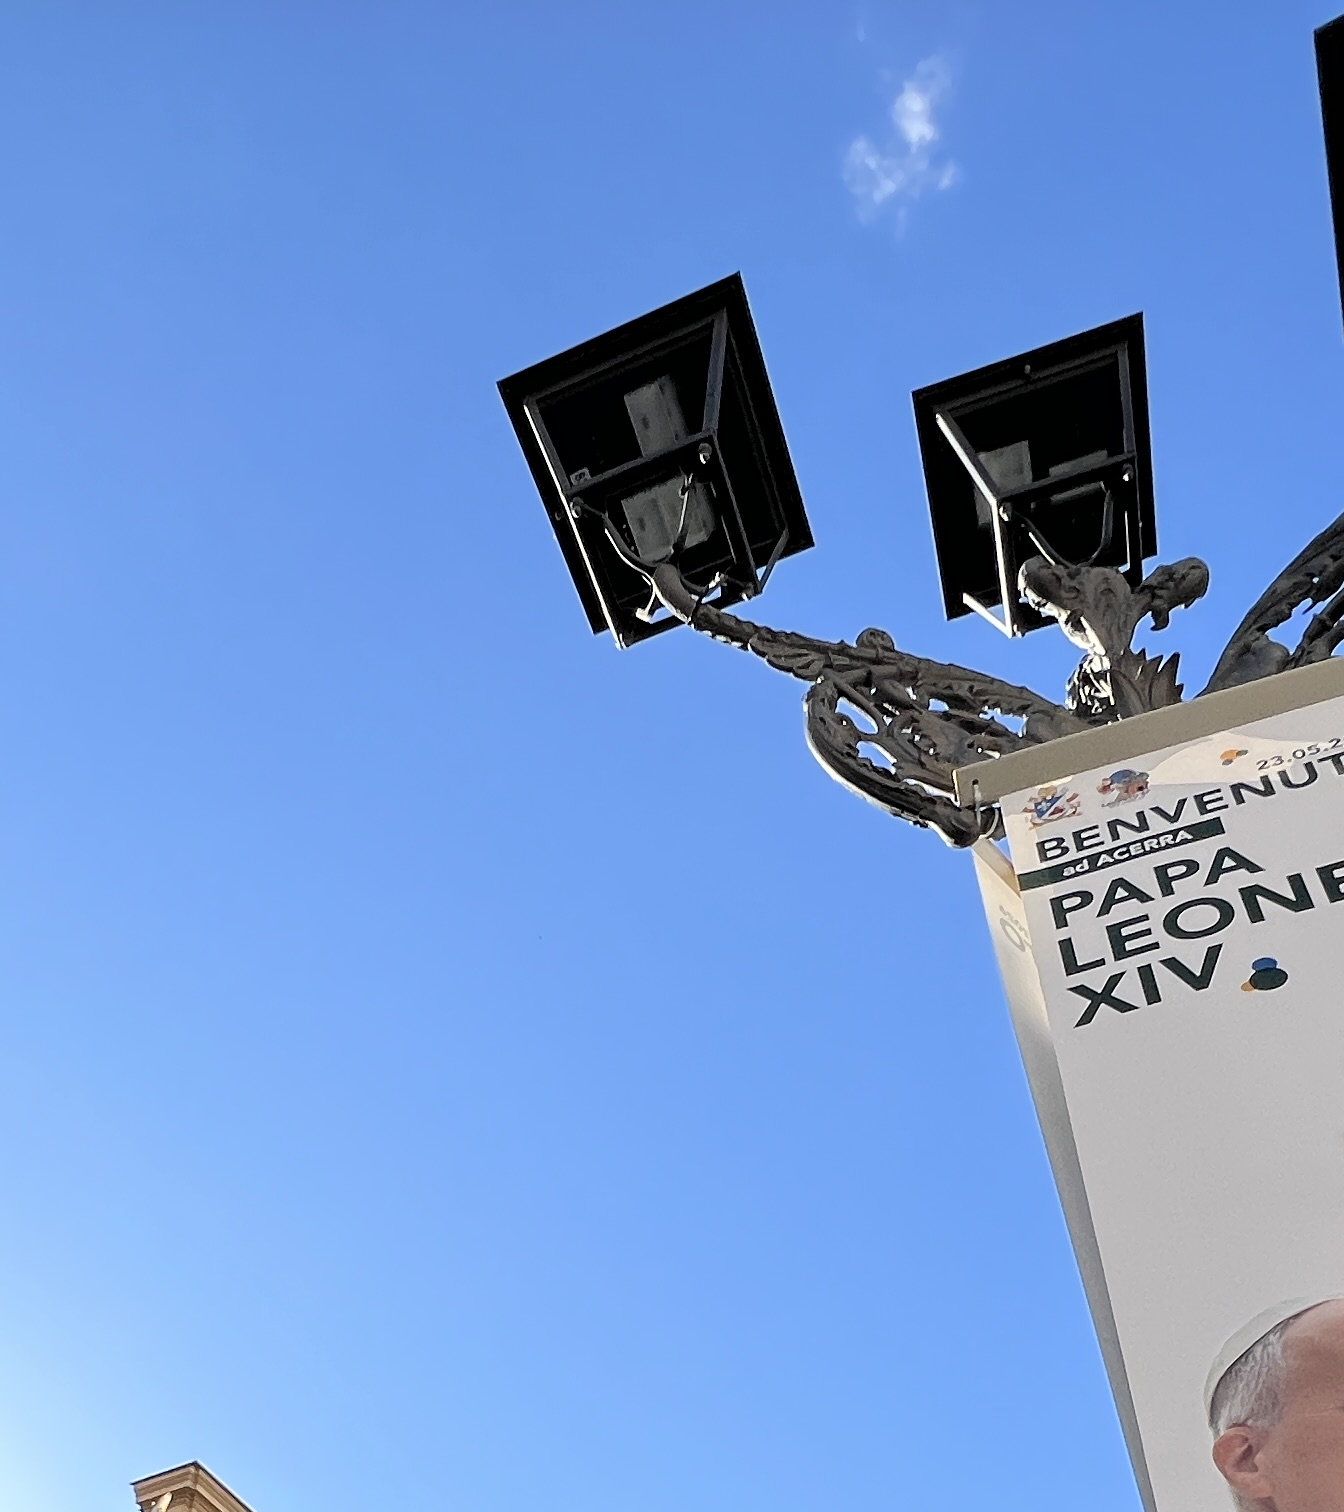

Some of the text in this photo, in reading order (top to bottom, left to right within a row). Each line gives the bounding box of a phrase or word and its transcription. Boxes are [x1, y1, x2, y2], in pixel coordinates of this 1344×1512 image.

[1048, 845, 1265, 930] PAPA
[1061, 828, 1194, 879] ad ACERRA
[1066, 943, 1224, 1030] XIV
